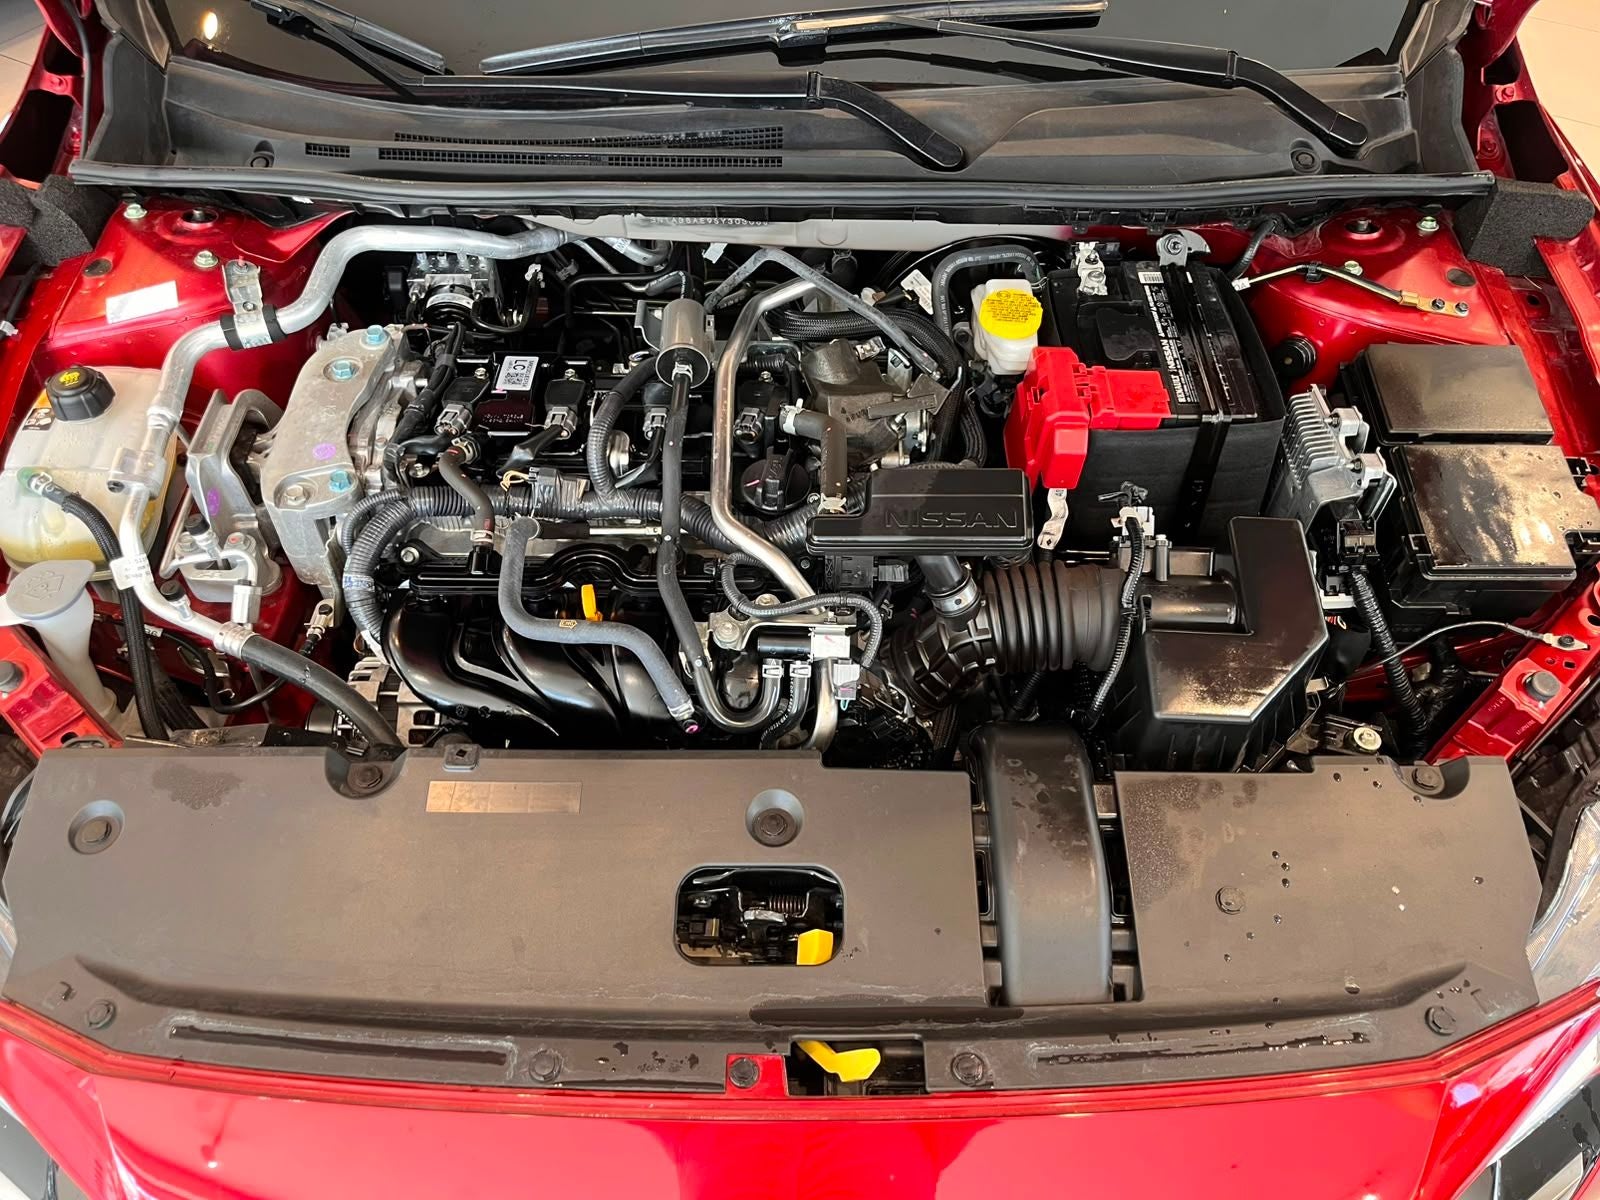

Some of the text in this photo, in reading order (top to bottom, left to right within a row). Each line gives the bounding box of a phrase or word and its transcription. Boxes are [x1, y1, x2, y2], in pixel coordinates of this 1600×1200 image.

[1160, 339, 1177, 368] NISSAN
[513, 360, 528, 371] LC
[1170, 374, 1187, 403] RENAULT
[886, 511, 1017, 528] NISSAN
